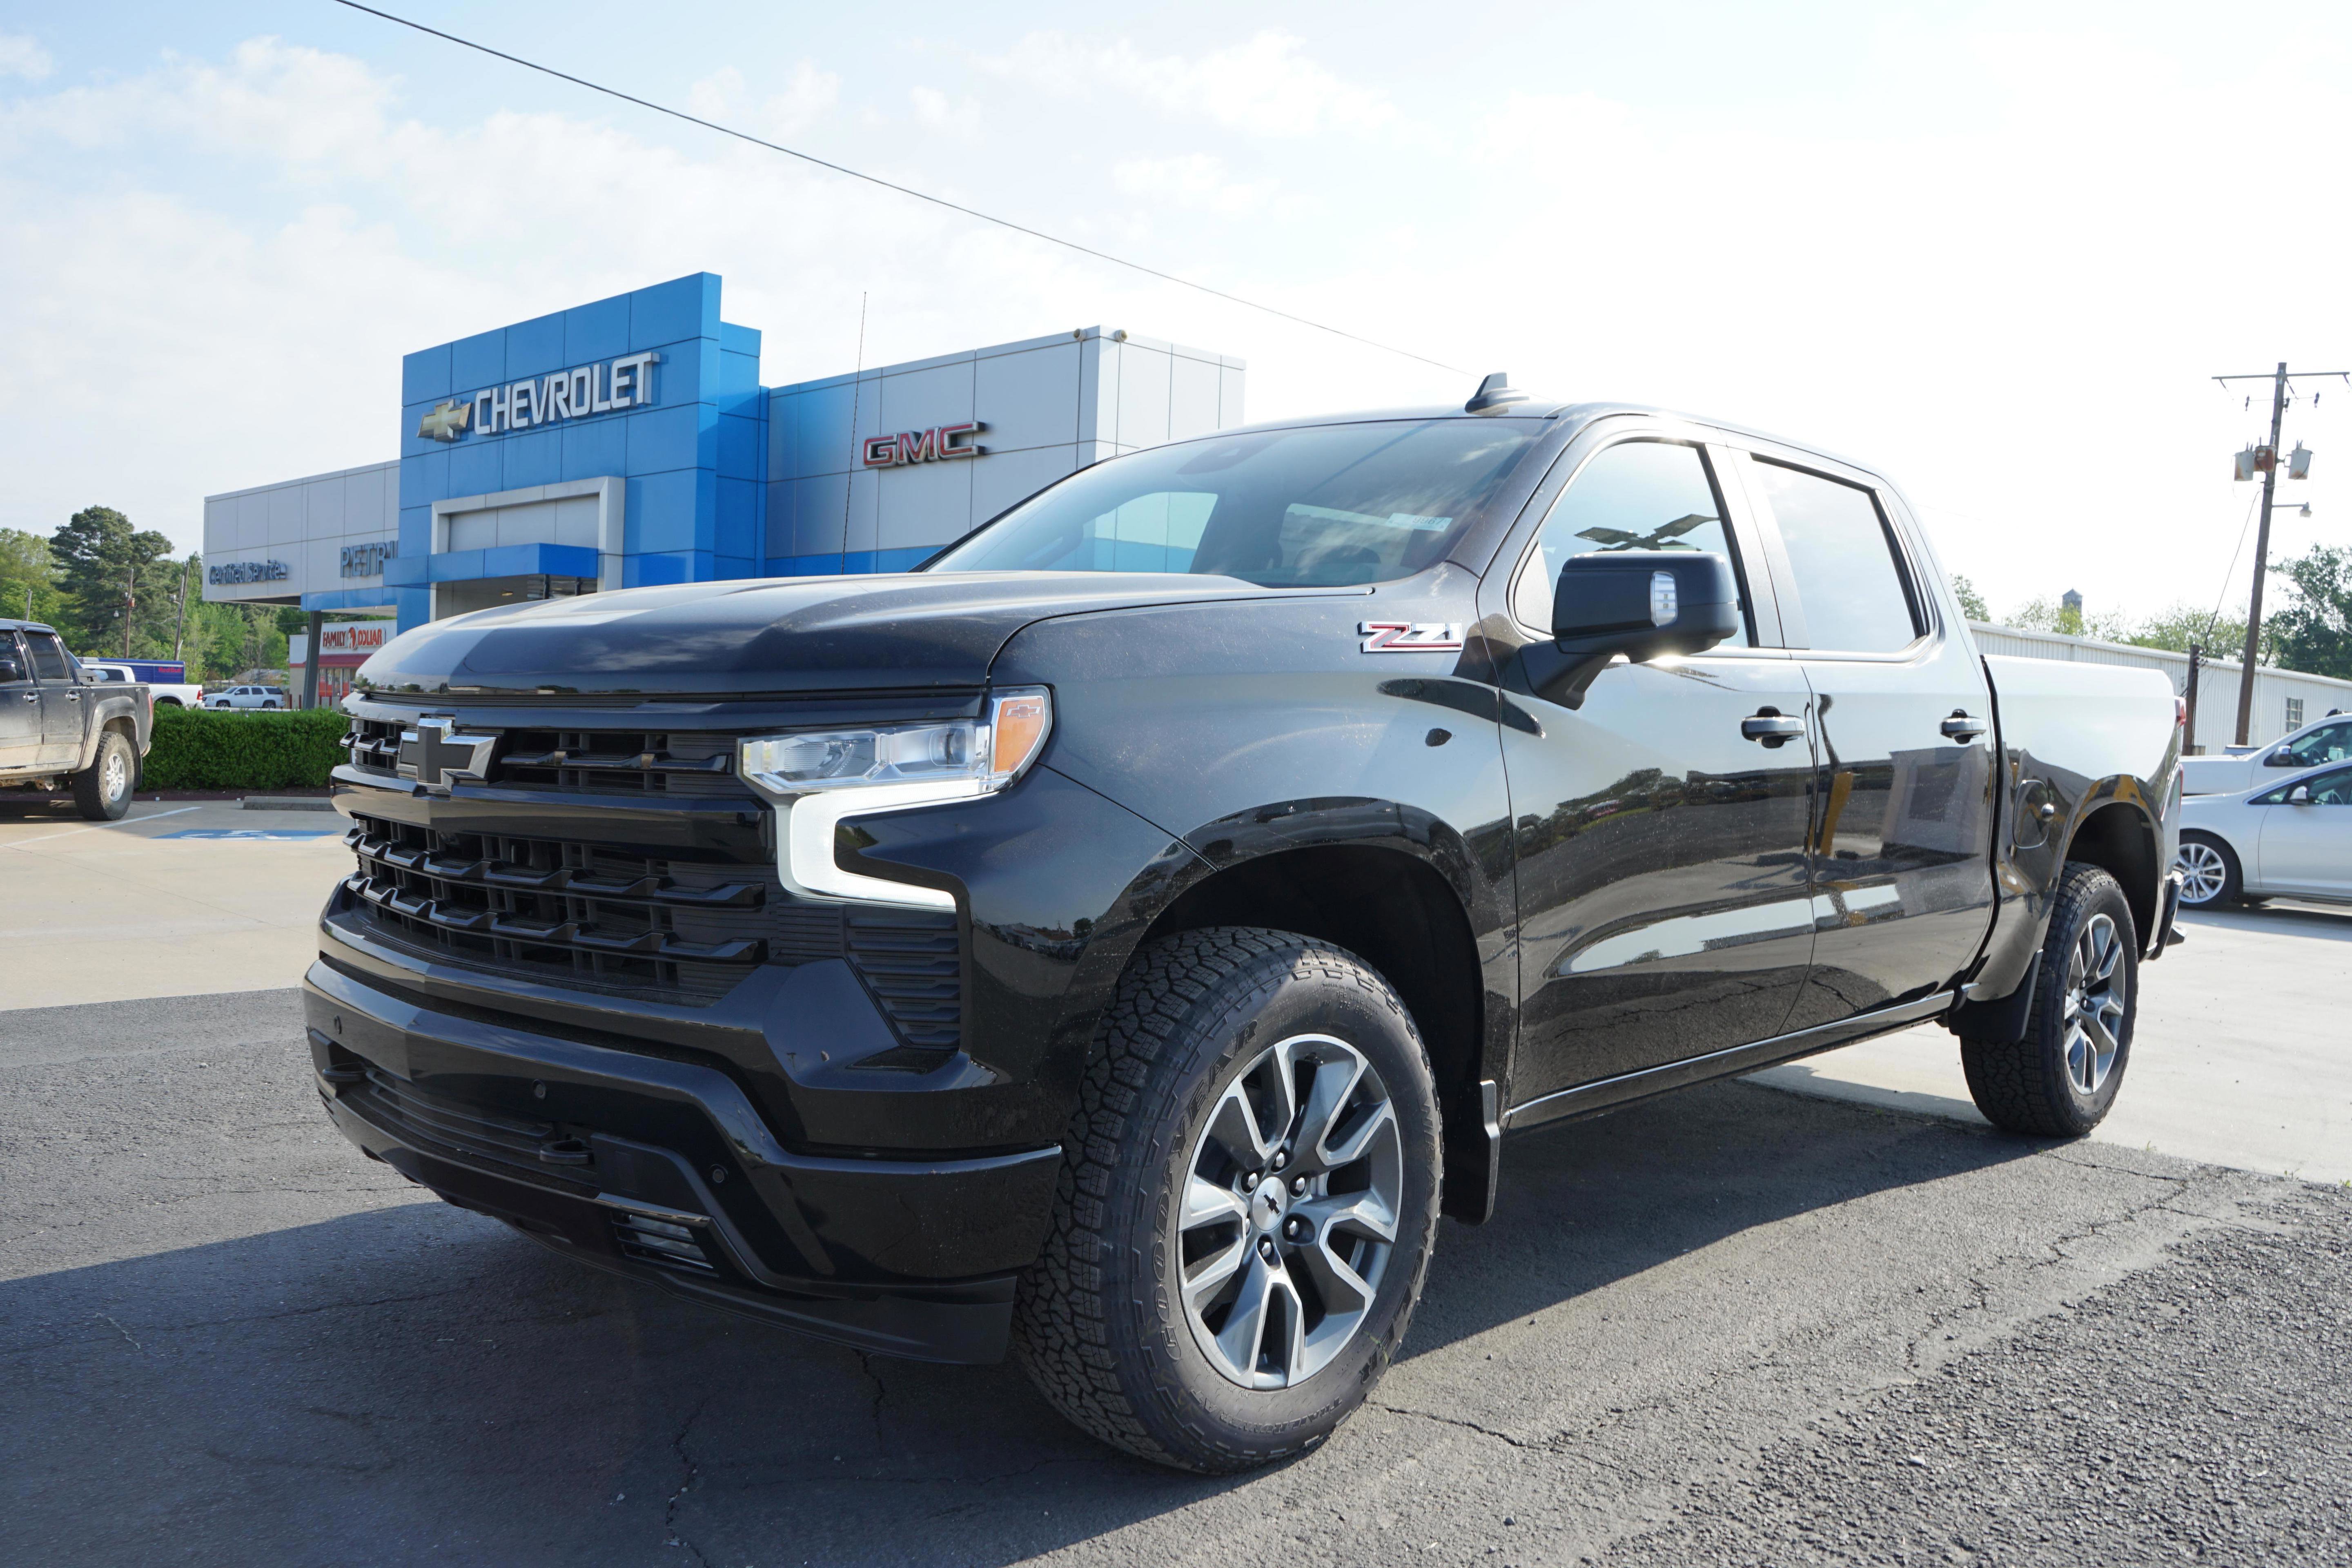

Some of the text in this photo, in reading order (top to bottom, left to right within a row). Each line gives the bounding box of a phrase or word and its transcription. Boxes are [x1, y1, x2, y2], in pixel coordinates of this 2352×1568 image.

[474, 352, 659, 435] CHEVROLET
[863, 421, 987, 468] GMC
[209, 559, 287, 585] Certified Service
[323, 628, 382, 647] FAMILY DOLLAR
[1358, 621, 1463, 653] Z71
[1153, 1019, 1258, 1361] GOODYEAR
